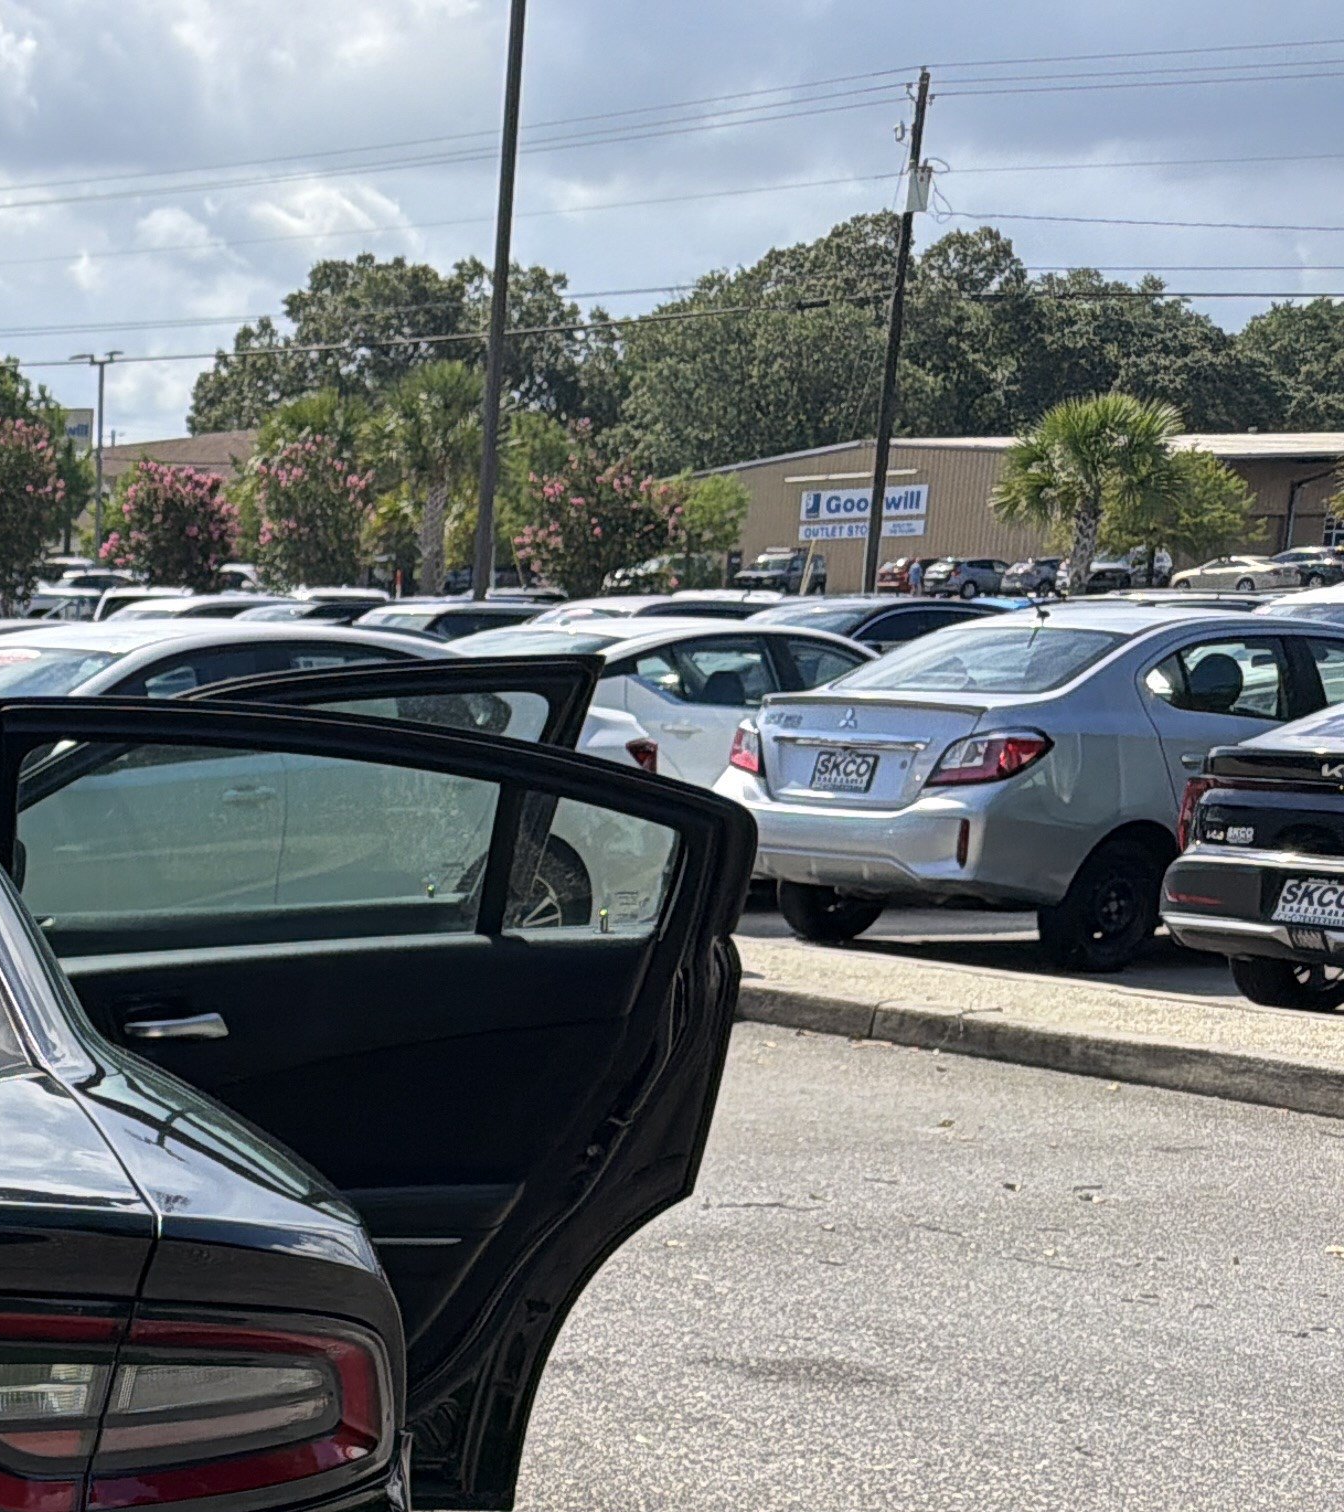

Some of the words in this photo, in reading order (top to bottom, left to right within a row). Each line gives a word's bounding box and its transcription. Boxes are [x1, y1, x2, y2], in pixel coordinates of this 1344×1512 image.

[826, 490, 921, 514] Goowill
[804, 525, 844, 538] OUTLET
[847, 524, 868, 537] STO
[817, 755, 872, 778] SKCO
